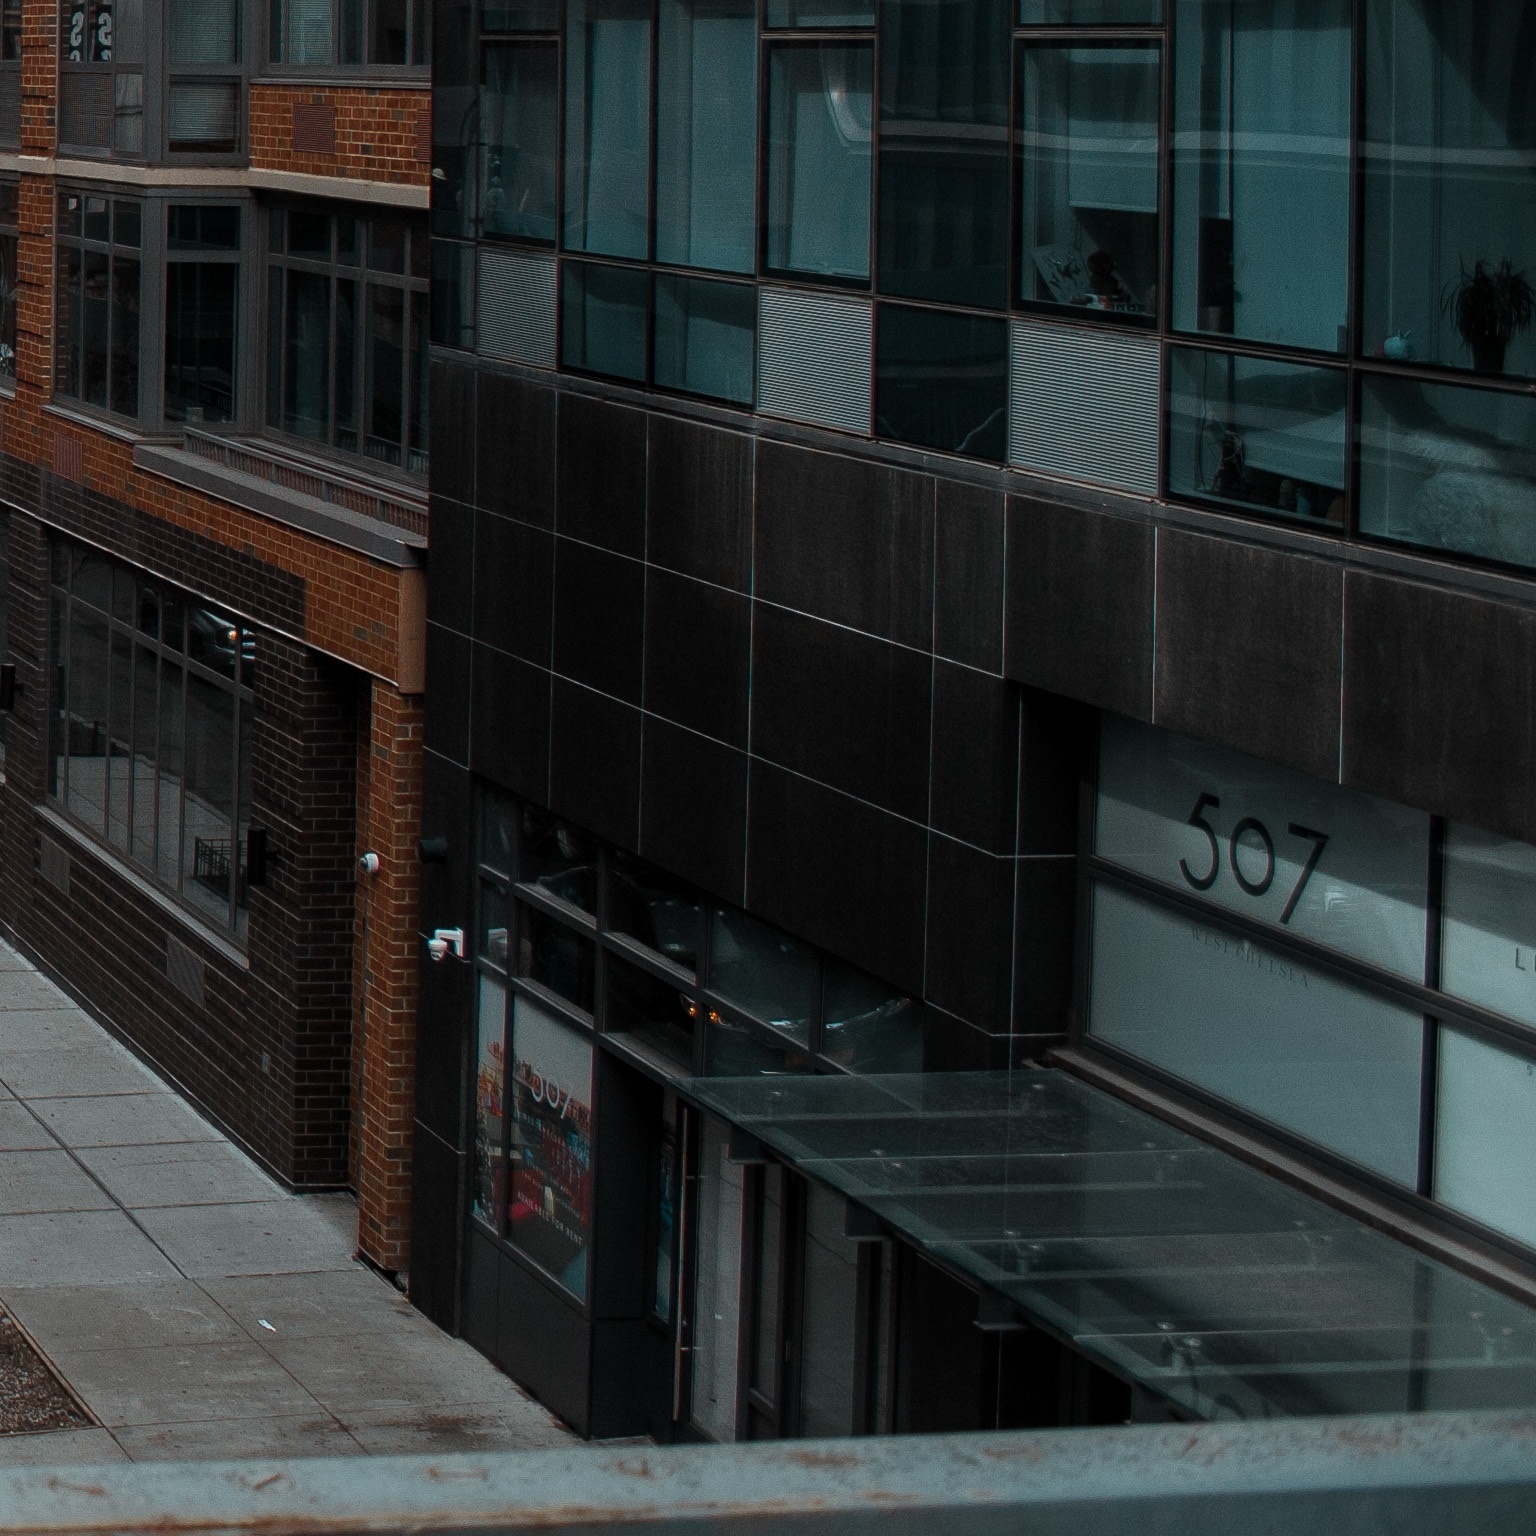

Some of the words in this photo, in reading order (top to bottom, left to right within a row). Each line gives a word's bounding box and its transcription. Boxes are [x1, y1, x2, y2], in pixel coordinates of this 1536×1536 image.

[1178, 791, 1331, 925] 507
[517, 1190, 550, 1222] AVAILABLE
[552, 1215, 564, 1232] FOR
[566, 1227, 584, 1245] RENT
